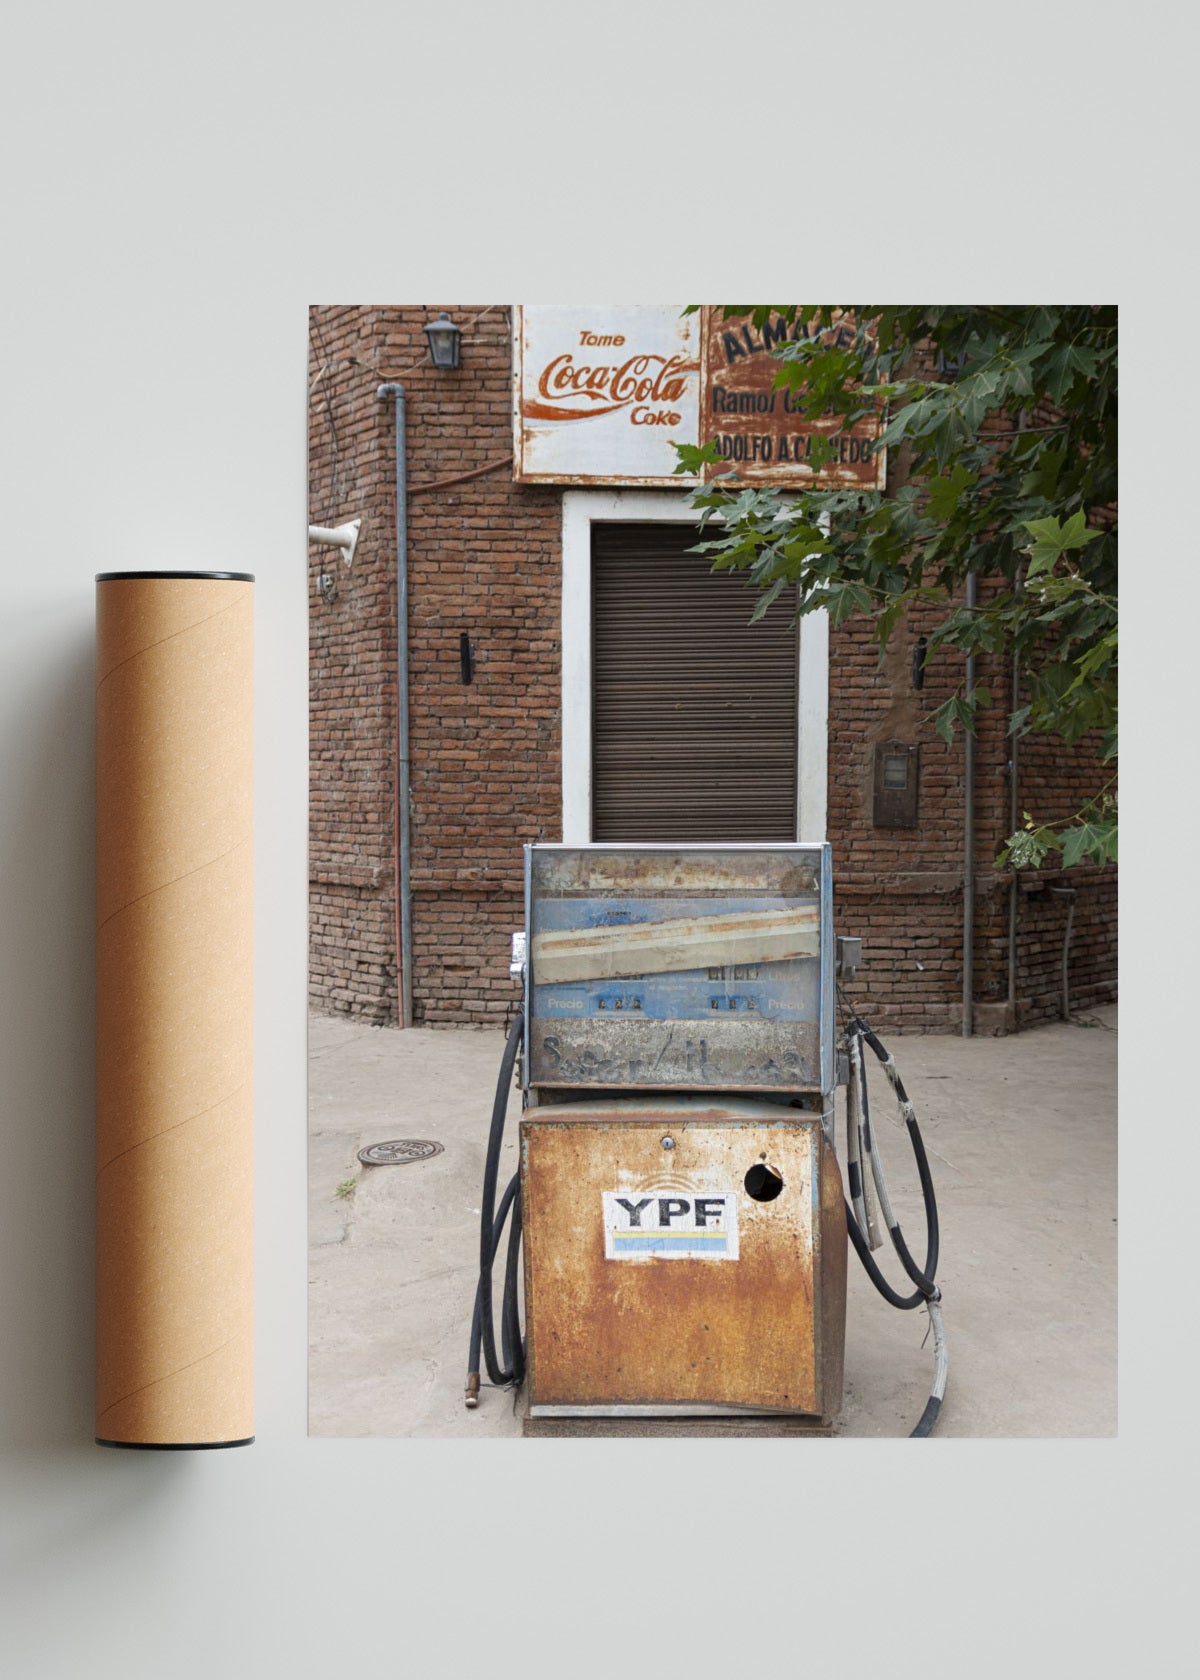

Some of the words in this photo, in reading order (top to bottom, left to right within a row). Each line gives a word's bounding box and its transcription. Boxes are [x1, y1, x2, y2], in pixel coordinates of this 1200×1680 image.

[579, 331, 626, 347] Tome
[722, 315, 876, 364] ALMCE
[538, 354, 687, 402] Coca-Cola
[630, 406, 682, 426] Coke
[713, 435, 772, 462] ADOLFO
[547, 999, 583, 1009] Precio
[768, 999, 805, 1010] Precio
[614, 1198, 725, 1226] YPF
